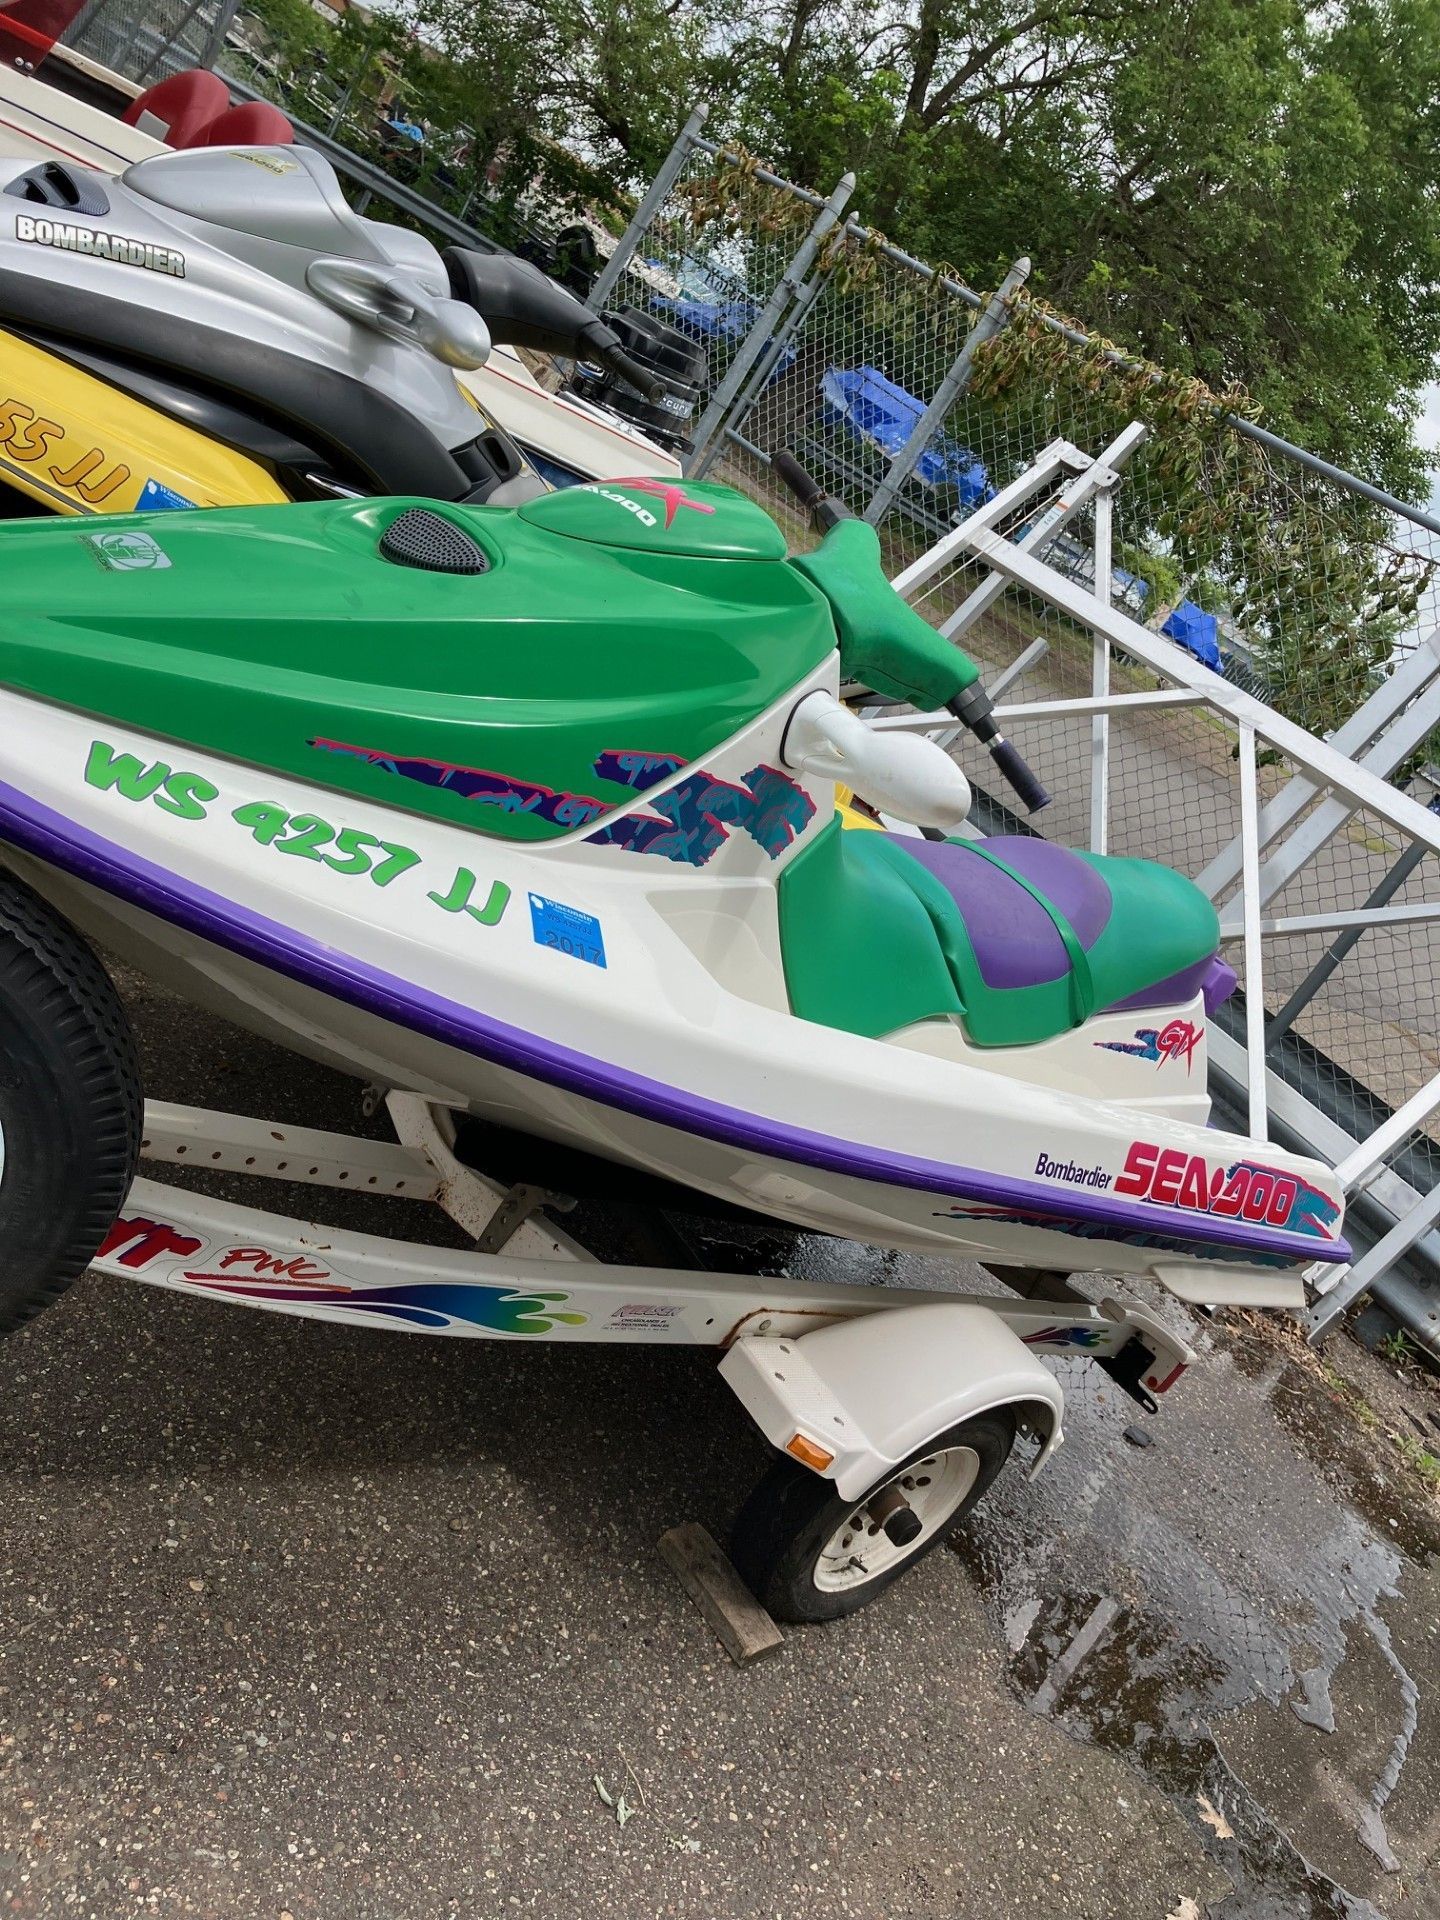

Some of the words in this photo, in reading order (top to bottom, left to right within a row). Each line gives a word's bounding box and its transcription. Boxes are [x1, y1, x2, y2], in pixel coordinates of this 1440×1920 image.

[15, 213, 186, 279] BOMBARDIER
[48, 447, 131, 503] JJ
[159, 485, 200, 509] Wisconsi
[84, 740, 220, 820] WS
[231, 799, 423, 888] 4257
[426, 866, 512, 927] JJ
[543, 898, 593, 923] Wisconsin
[545, 930, 601, 965] 2017
[1034, 1152, 1113, 1190] Bombardier
[219, 1248, 331, 1280] PWC
